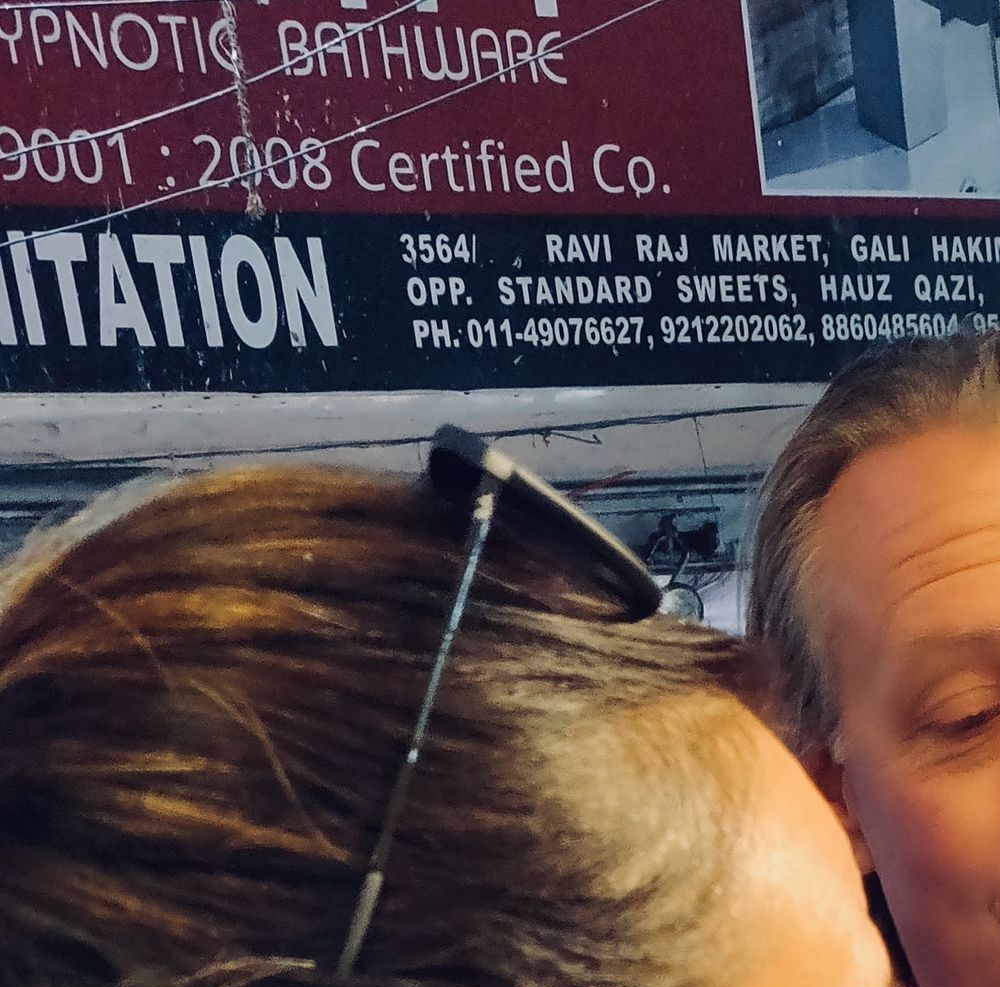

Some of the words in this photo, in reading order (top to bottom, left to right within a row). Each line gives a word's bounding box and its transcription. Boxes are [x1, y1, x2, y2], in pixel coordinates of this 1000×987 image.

[278, 20, 567, 84] BATHWARE
[193, 134, 332, 191] 2008
[351, 139, 574, 192] Certified
[593, 143, 671, 194] Co.
[546, 234, 612, 263] RAVI
[636, 234, 689, 263] RAJ
[712, 234, 829, 268] MARKET,
[850, 235, 910, 262] GALI
[407, 276, 473, 306] OPP.
[498, 275, 652, 305] STANDARD
[677, 274, 798, 307] SWEETS,
[820, 274, 893, 302] HAUZ
[914, 274, 985, 307] QAZI,
